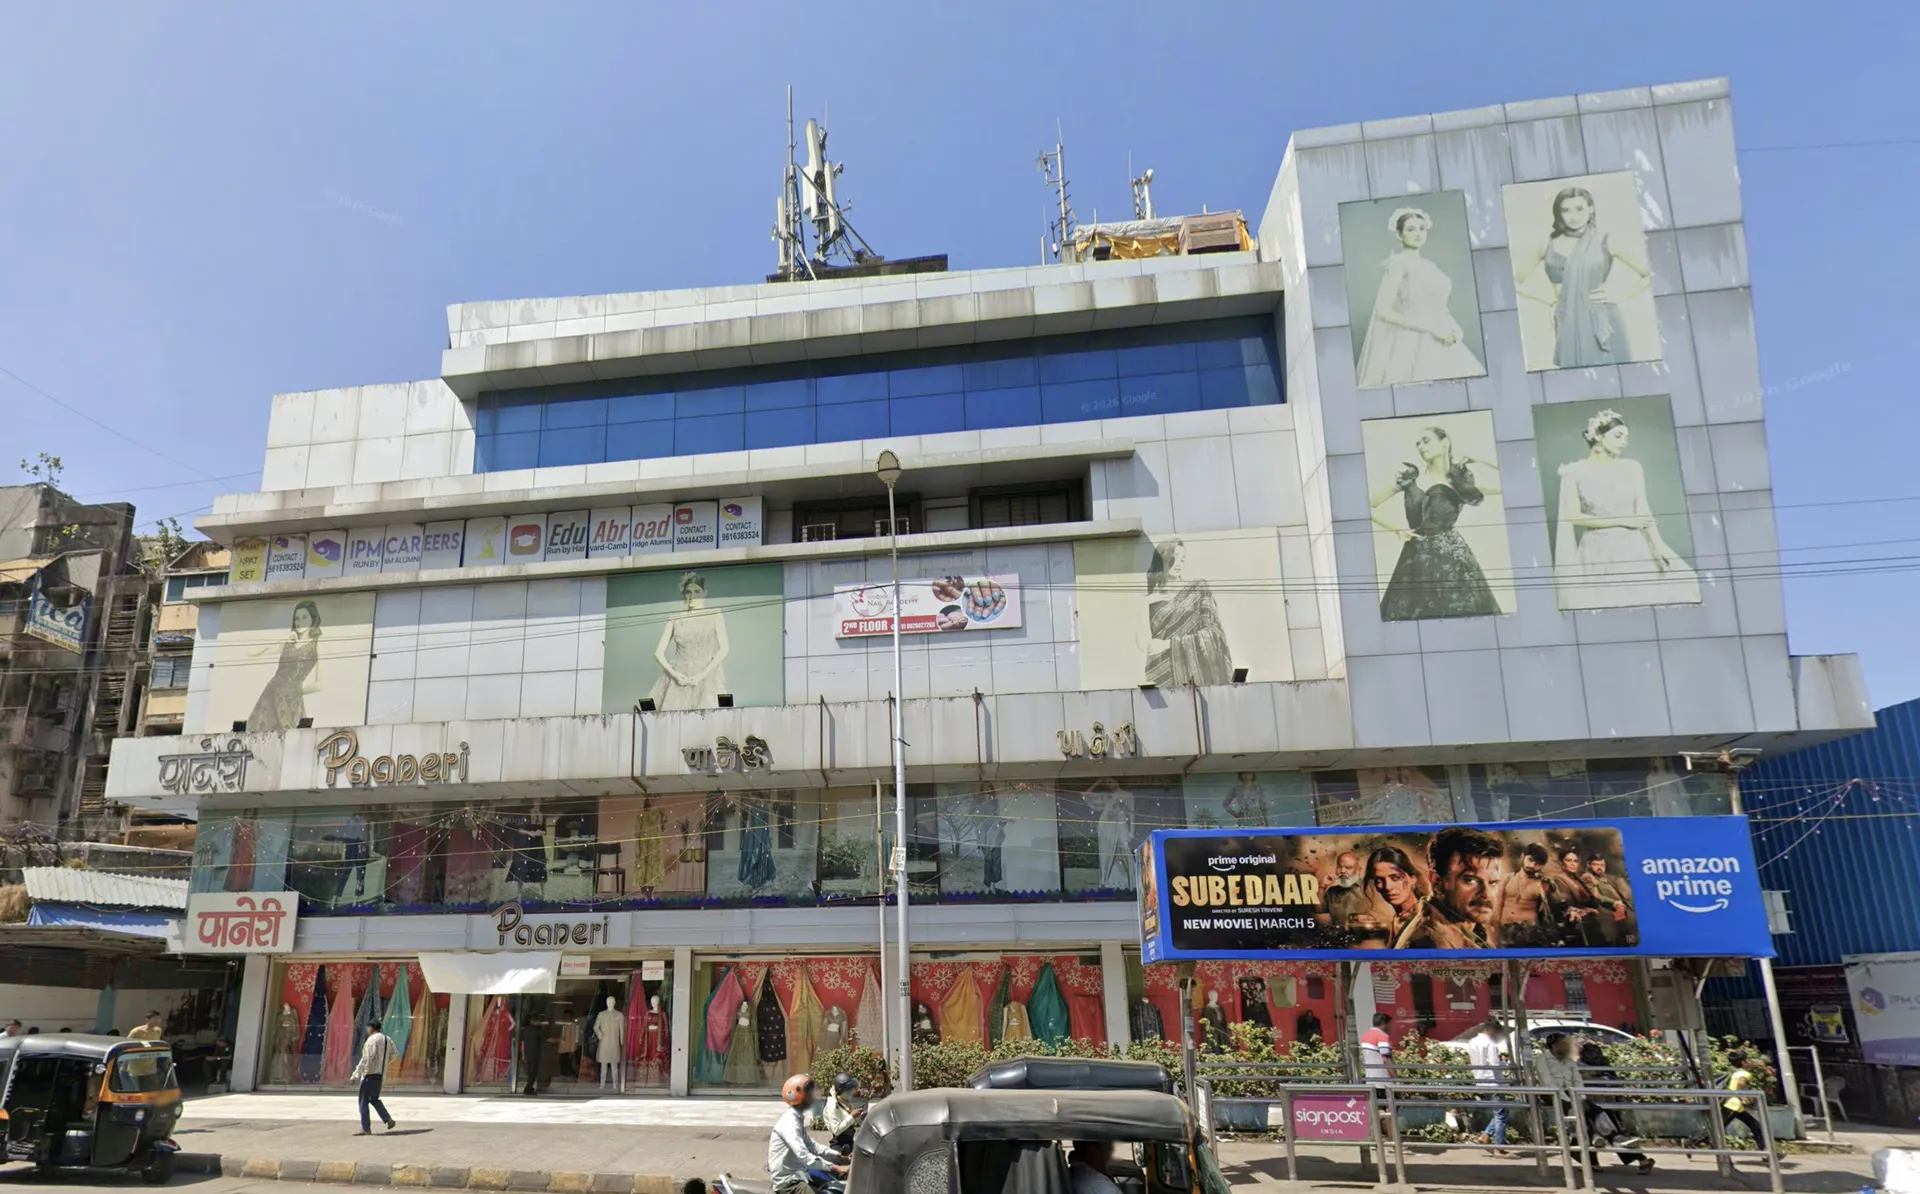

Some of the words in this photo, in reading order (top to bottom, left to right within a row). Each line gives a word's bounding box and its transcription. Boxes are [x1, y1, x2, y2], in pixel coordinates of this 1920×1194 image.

[679, 525, 706, 535] CONTACT
[725, 521, 751, 531] CONTACT
[548, 521, 586, 547] Edu
[721, 531, 760, 541] 9616383524
[350, 538, 382, 559] IPM
[386, 533, 460, 554] CAREERS
[562, 546, 570, 554] by
[272, 553, 298, 562] CONTACT
[239, 570, 255, 580] SET
[860, 620, 888, 632] FLOOR
[317, 730, 469, 786] Paaneri
[1208, 855, 1238, 867] prime
[1239, 854, 1276, 866] original
[1642, 857, 1740, 875] amazon
[1172, 874, 1320, 907] SUBEDAAR
[1656, 875, 1732, 900] prime
[197, 896, 287, 948] पानेरी
[490, 902, 610, 945] Paaneri
[1183, 919, 1211, 930] NEW
[1213, 918, 1253, 930] MOVIE
[1260, 918, 1304, 929] MARCH
[1307, 917, 1315, 929] 5
[1296, 1107, 1363, 1126] signpost
